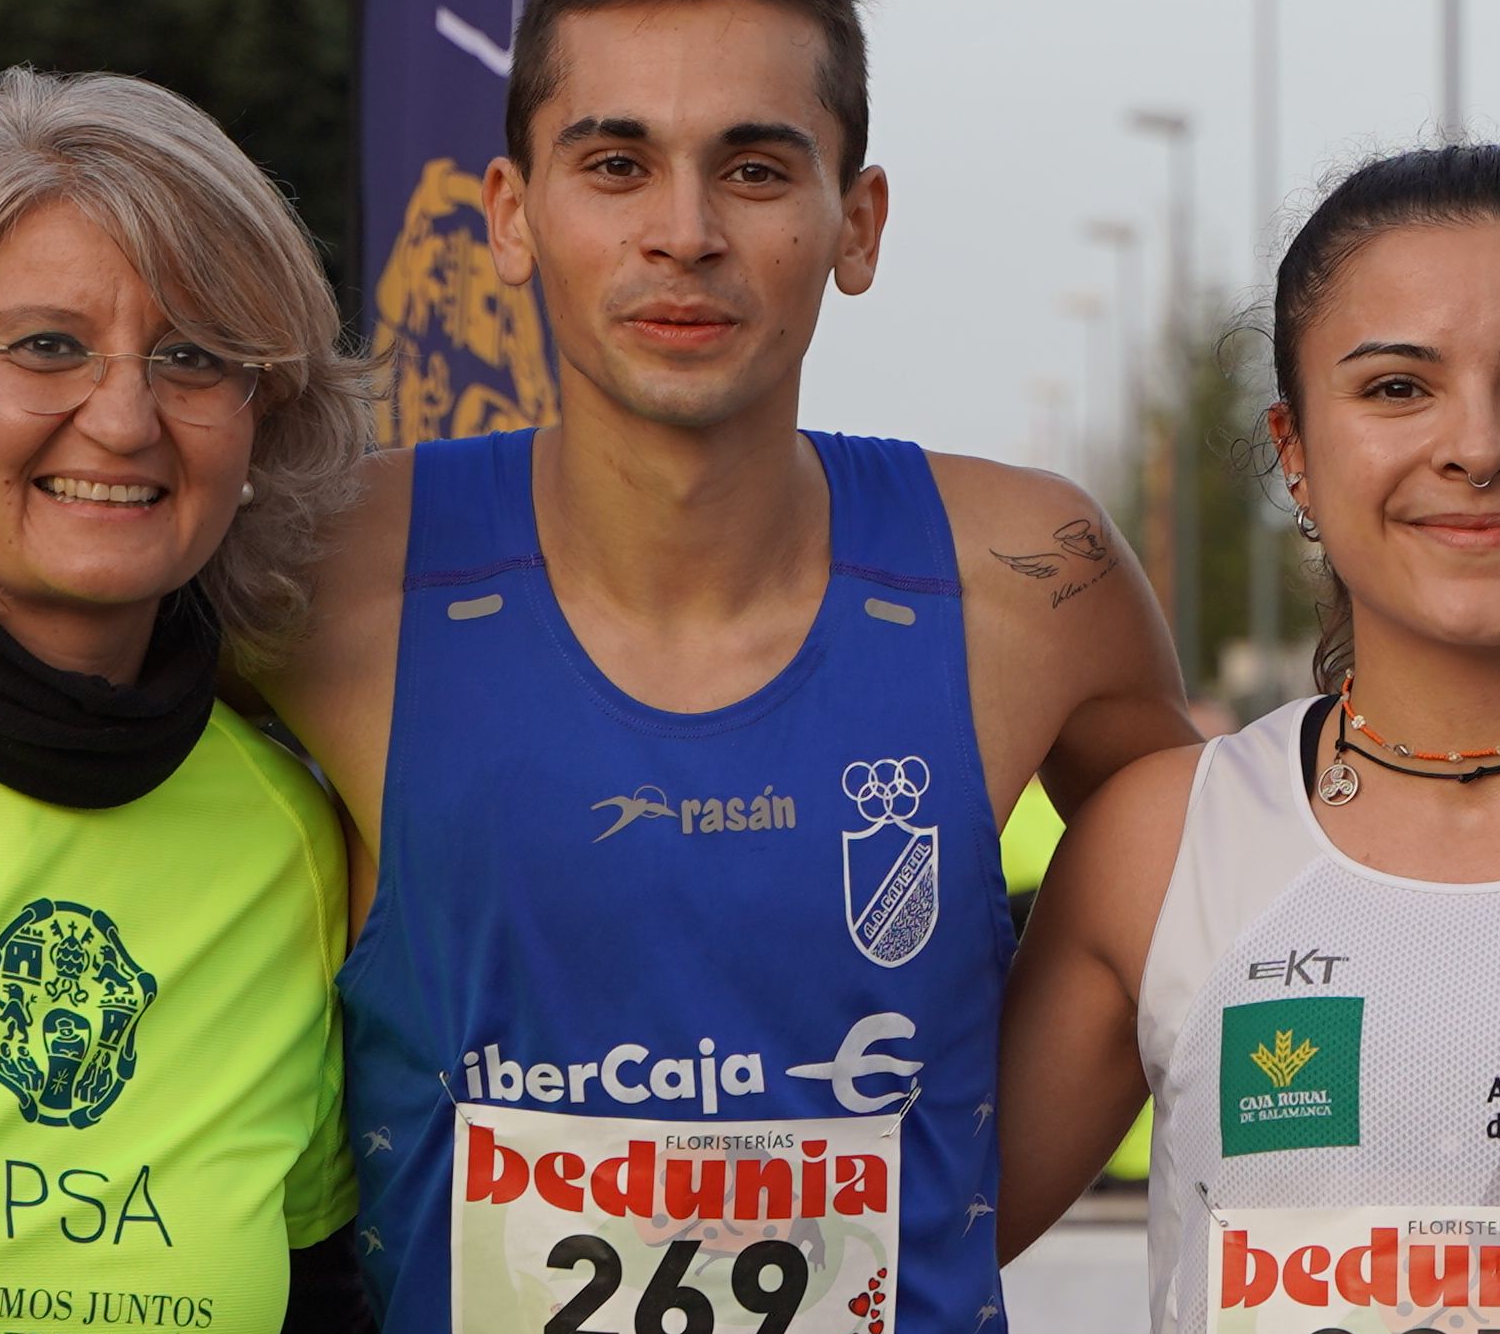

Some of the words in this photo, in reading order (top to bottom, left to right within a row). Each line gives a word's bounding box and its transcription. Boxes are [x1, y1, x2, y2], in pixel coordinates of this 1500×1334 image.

[681, 785, 796, 835] rasán
[463, 1037, 765, 1115] iberCaja
[1239, 1094, 1274, 1110] CAJA
[1278, 1090, 1332, 1106] RURAL
[1240, 1112, 1256, 1123] DE
[1259, 1106, 1332, 1121] SALAMANCA
[664, 1131, 795, 1151] FLORISTERÍAS
[465, 1124, 888, 1220] bedunia
[82, 1291, 214, 1329] JUNTOS
